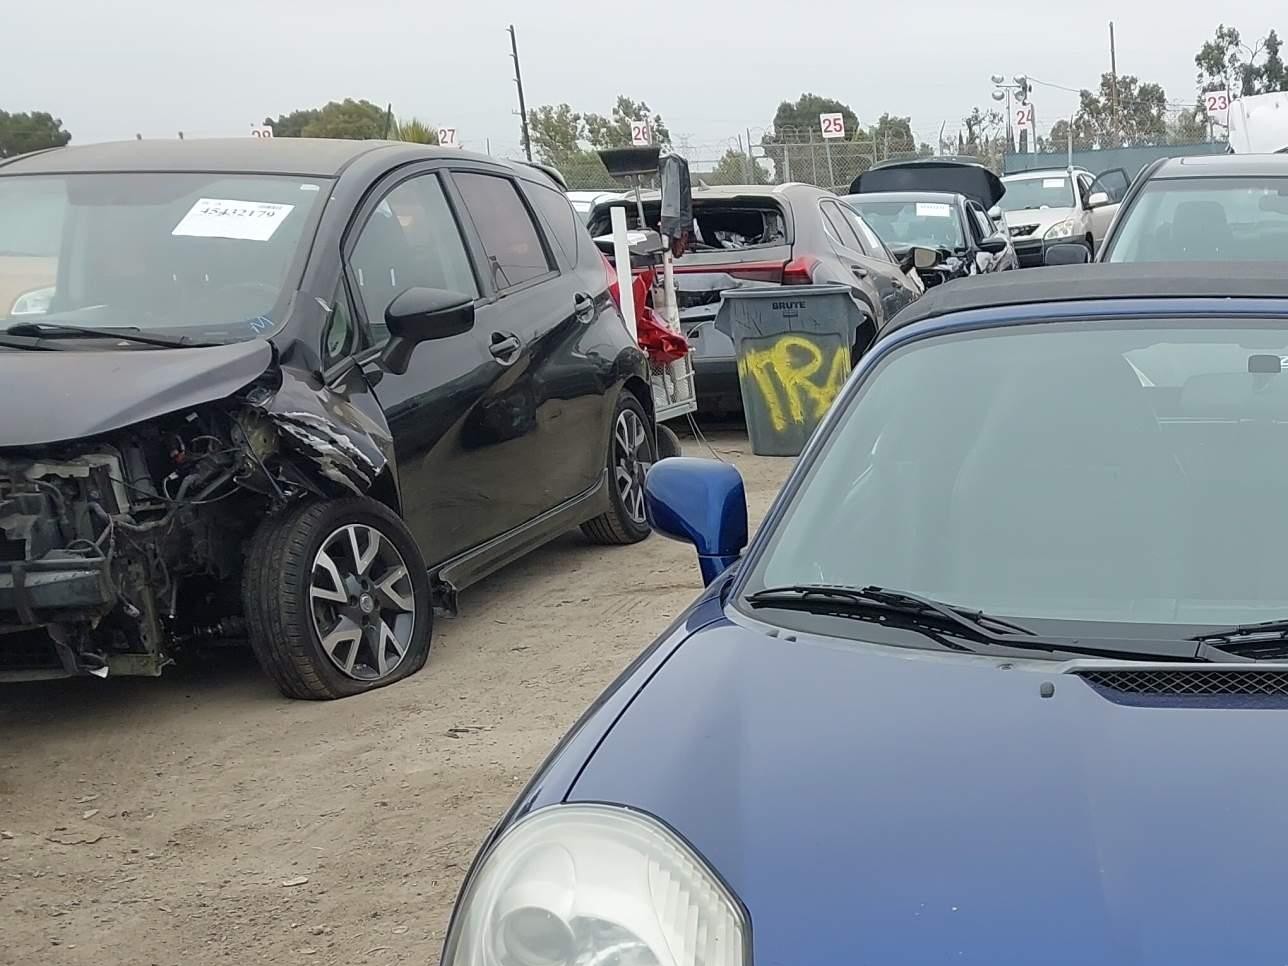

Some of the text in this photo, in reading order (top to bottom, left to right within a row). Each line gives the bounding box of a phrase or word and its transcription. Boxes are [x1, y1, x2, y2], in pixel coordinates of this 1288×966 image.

[1207, 95, 1228, 111] 23
[822, 117, 843, 133] 25
[1016, 109, 1033, 125] 24
[439, 128, 456, 144] 27
[632, 126, 649, 141] 26
[772, 301, 807, 310] BRUTE
